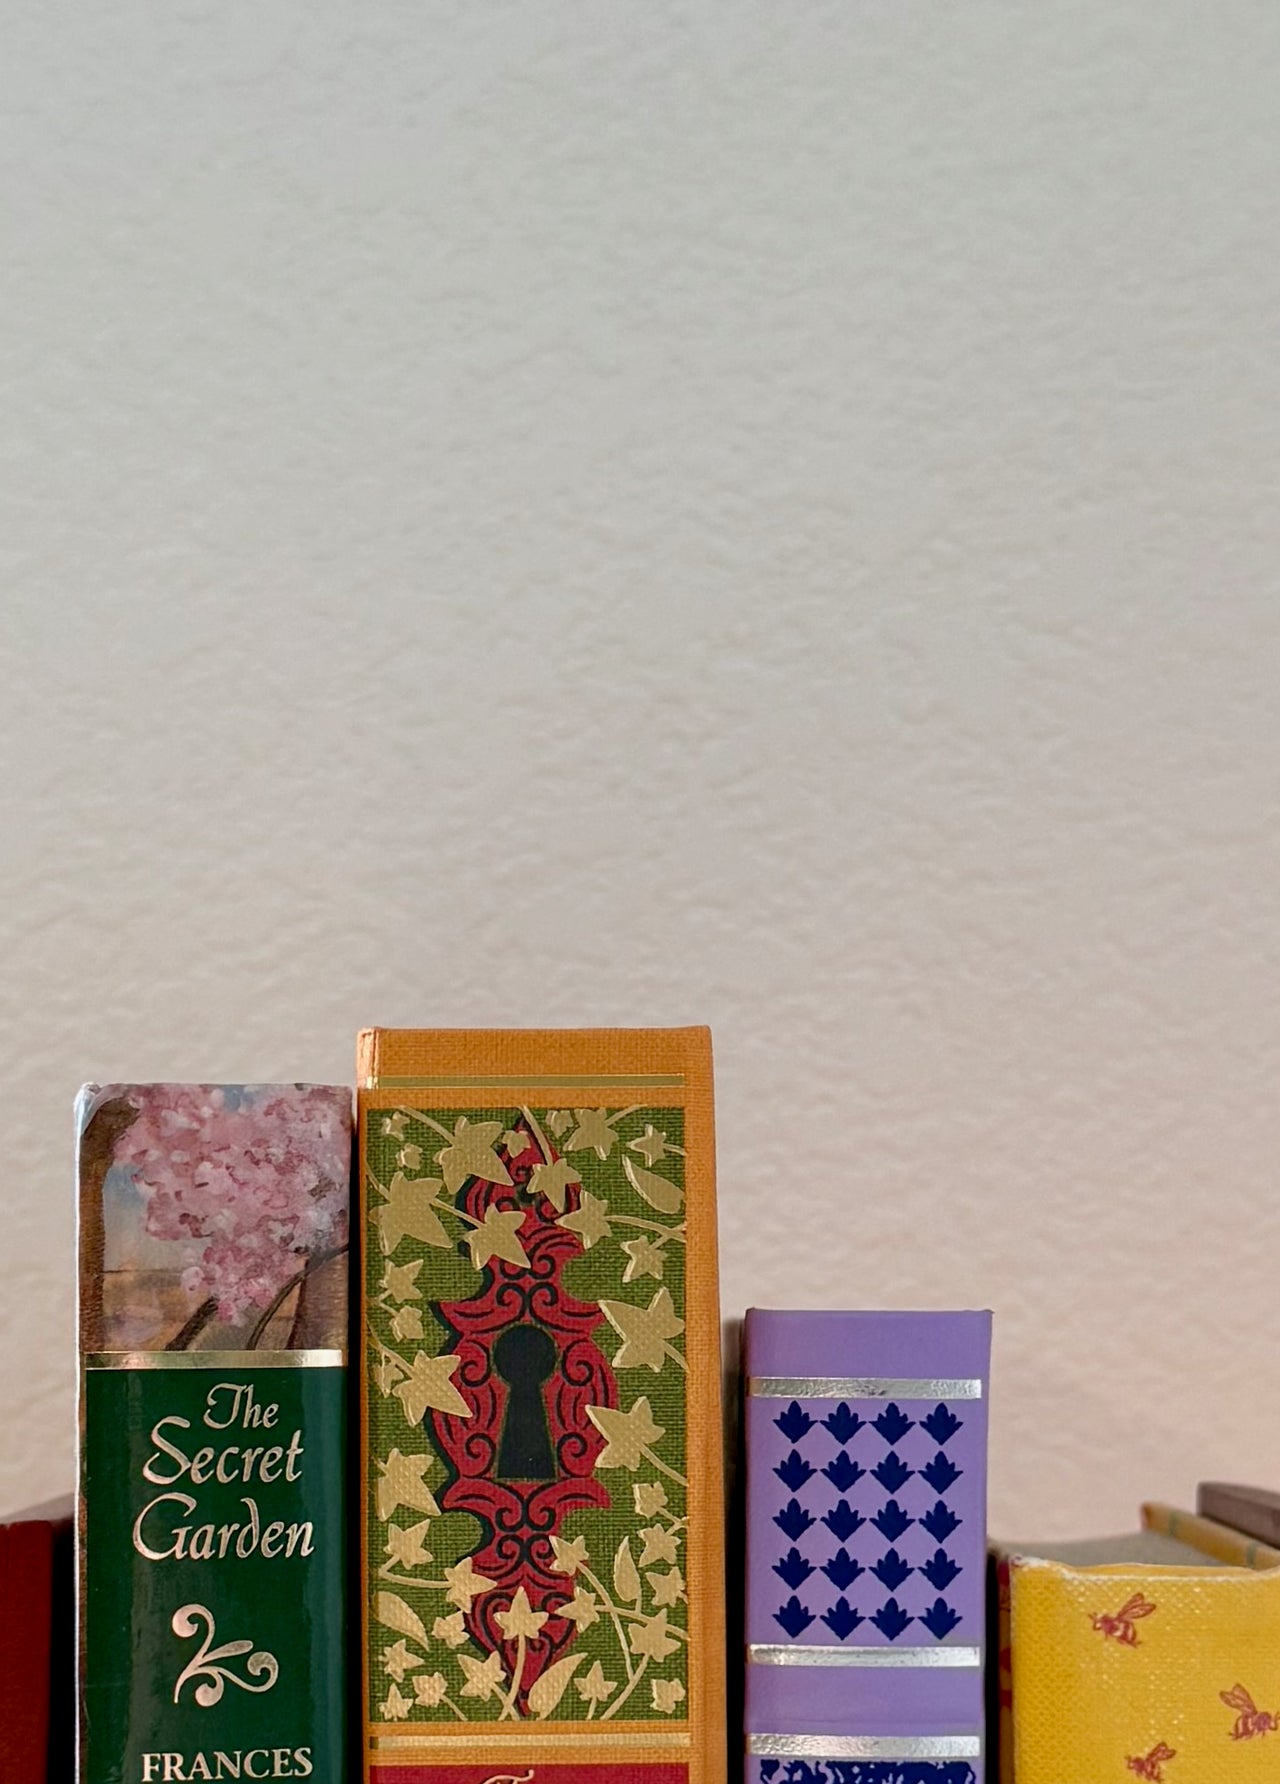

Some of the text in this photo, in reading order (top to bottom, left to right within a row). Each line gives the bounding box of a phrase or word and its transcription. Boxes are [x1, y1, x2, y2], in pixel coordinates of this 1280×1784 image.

[203, 1383, 279, 1429] The
[142, 1416, 304, 1485] Secret
[132, 1492, 314, 1560] Garden
[141, 1747, 313, 1782] FRANCES
